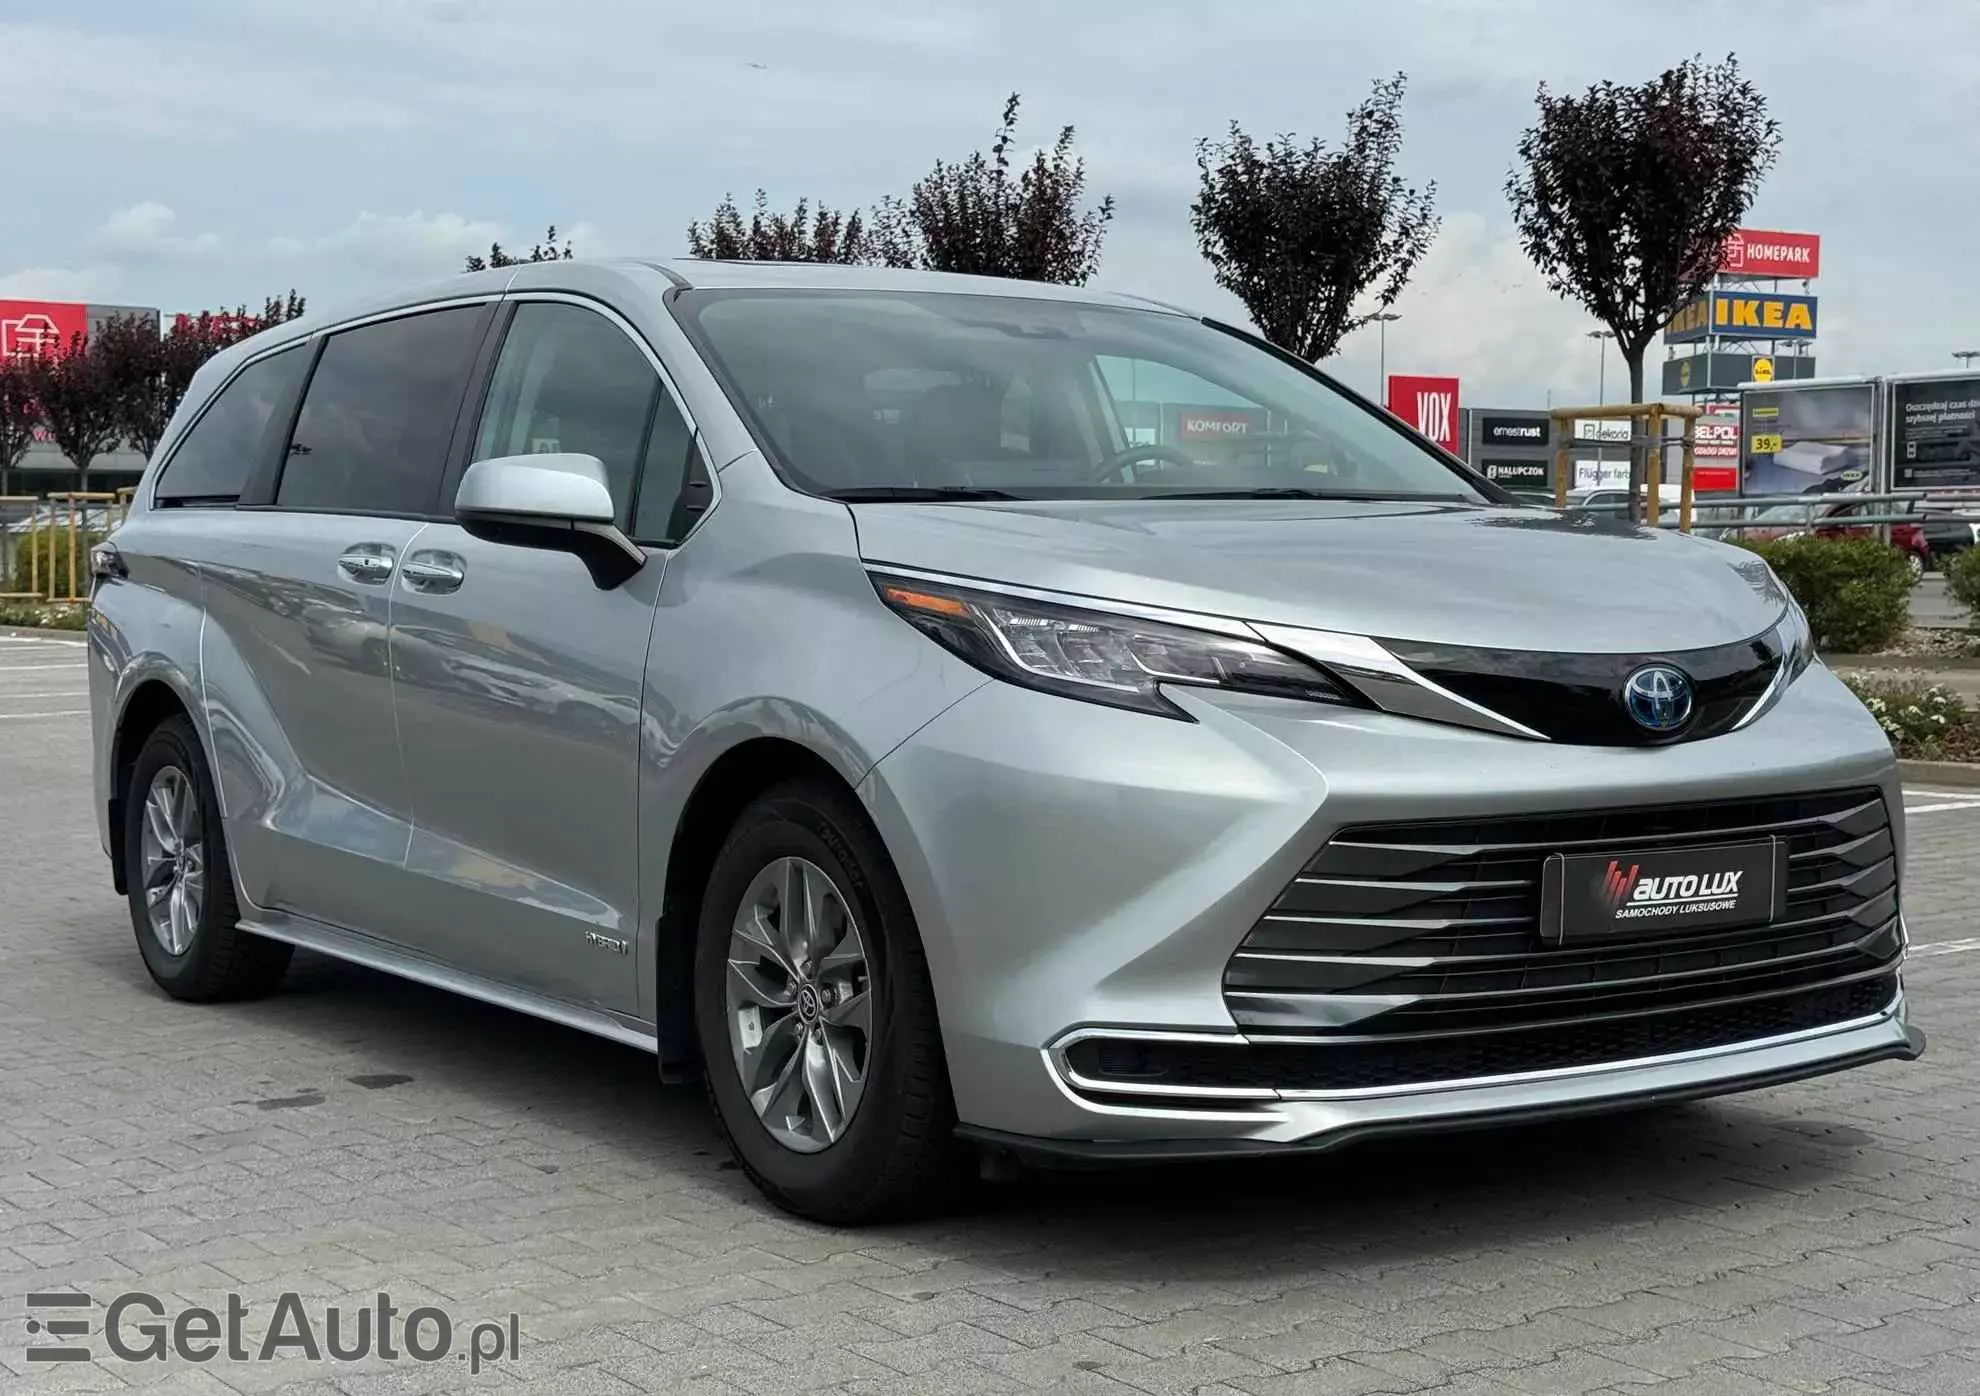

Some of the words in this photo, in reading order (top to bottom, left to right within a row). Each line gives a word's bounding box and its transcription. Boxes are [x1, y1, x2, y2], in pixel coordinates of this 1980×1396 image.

[1747, 243, 1811, 263] HOMEPARK
[1715, 298, 1813, 330] IKEA
[1187, 419, 1248, 434] KOMFORT
[1416, 391, 1452, 442] VOX
[1700, 871, 1743, 895] LUX
[1615, 905, 1679, 919] SAMOCHODY
[1679, 900, 1737, 914] LUKSUSOWE
